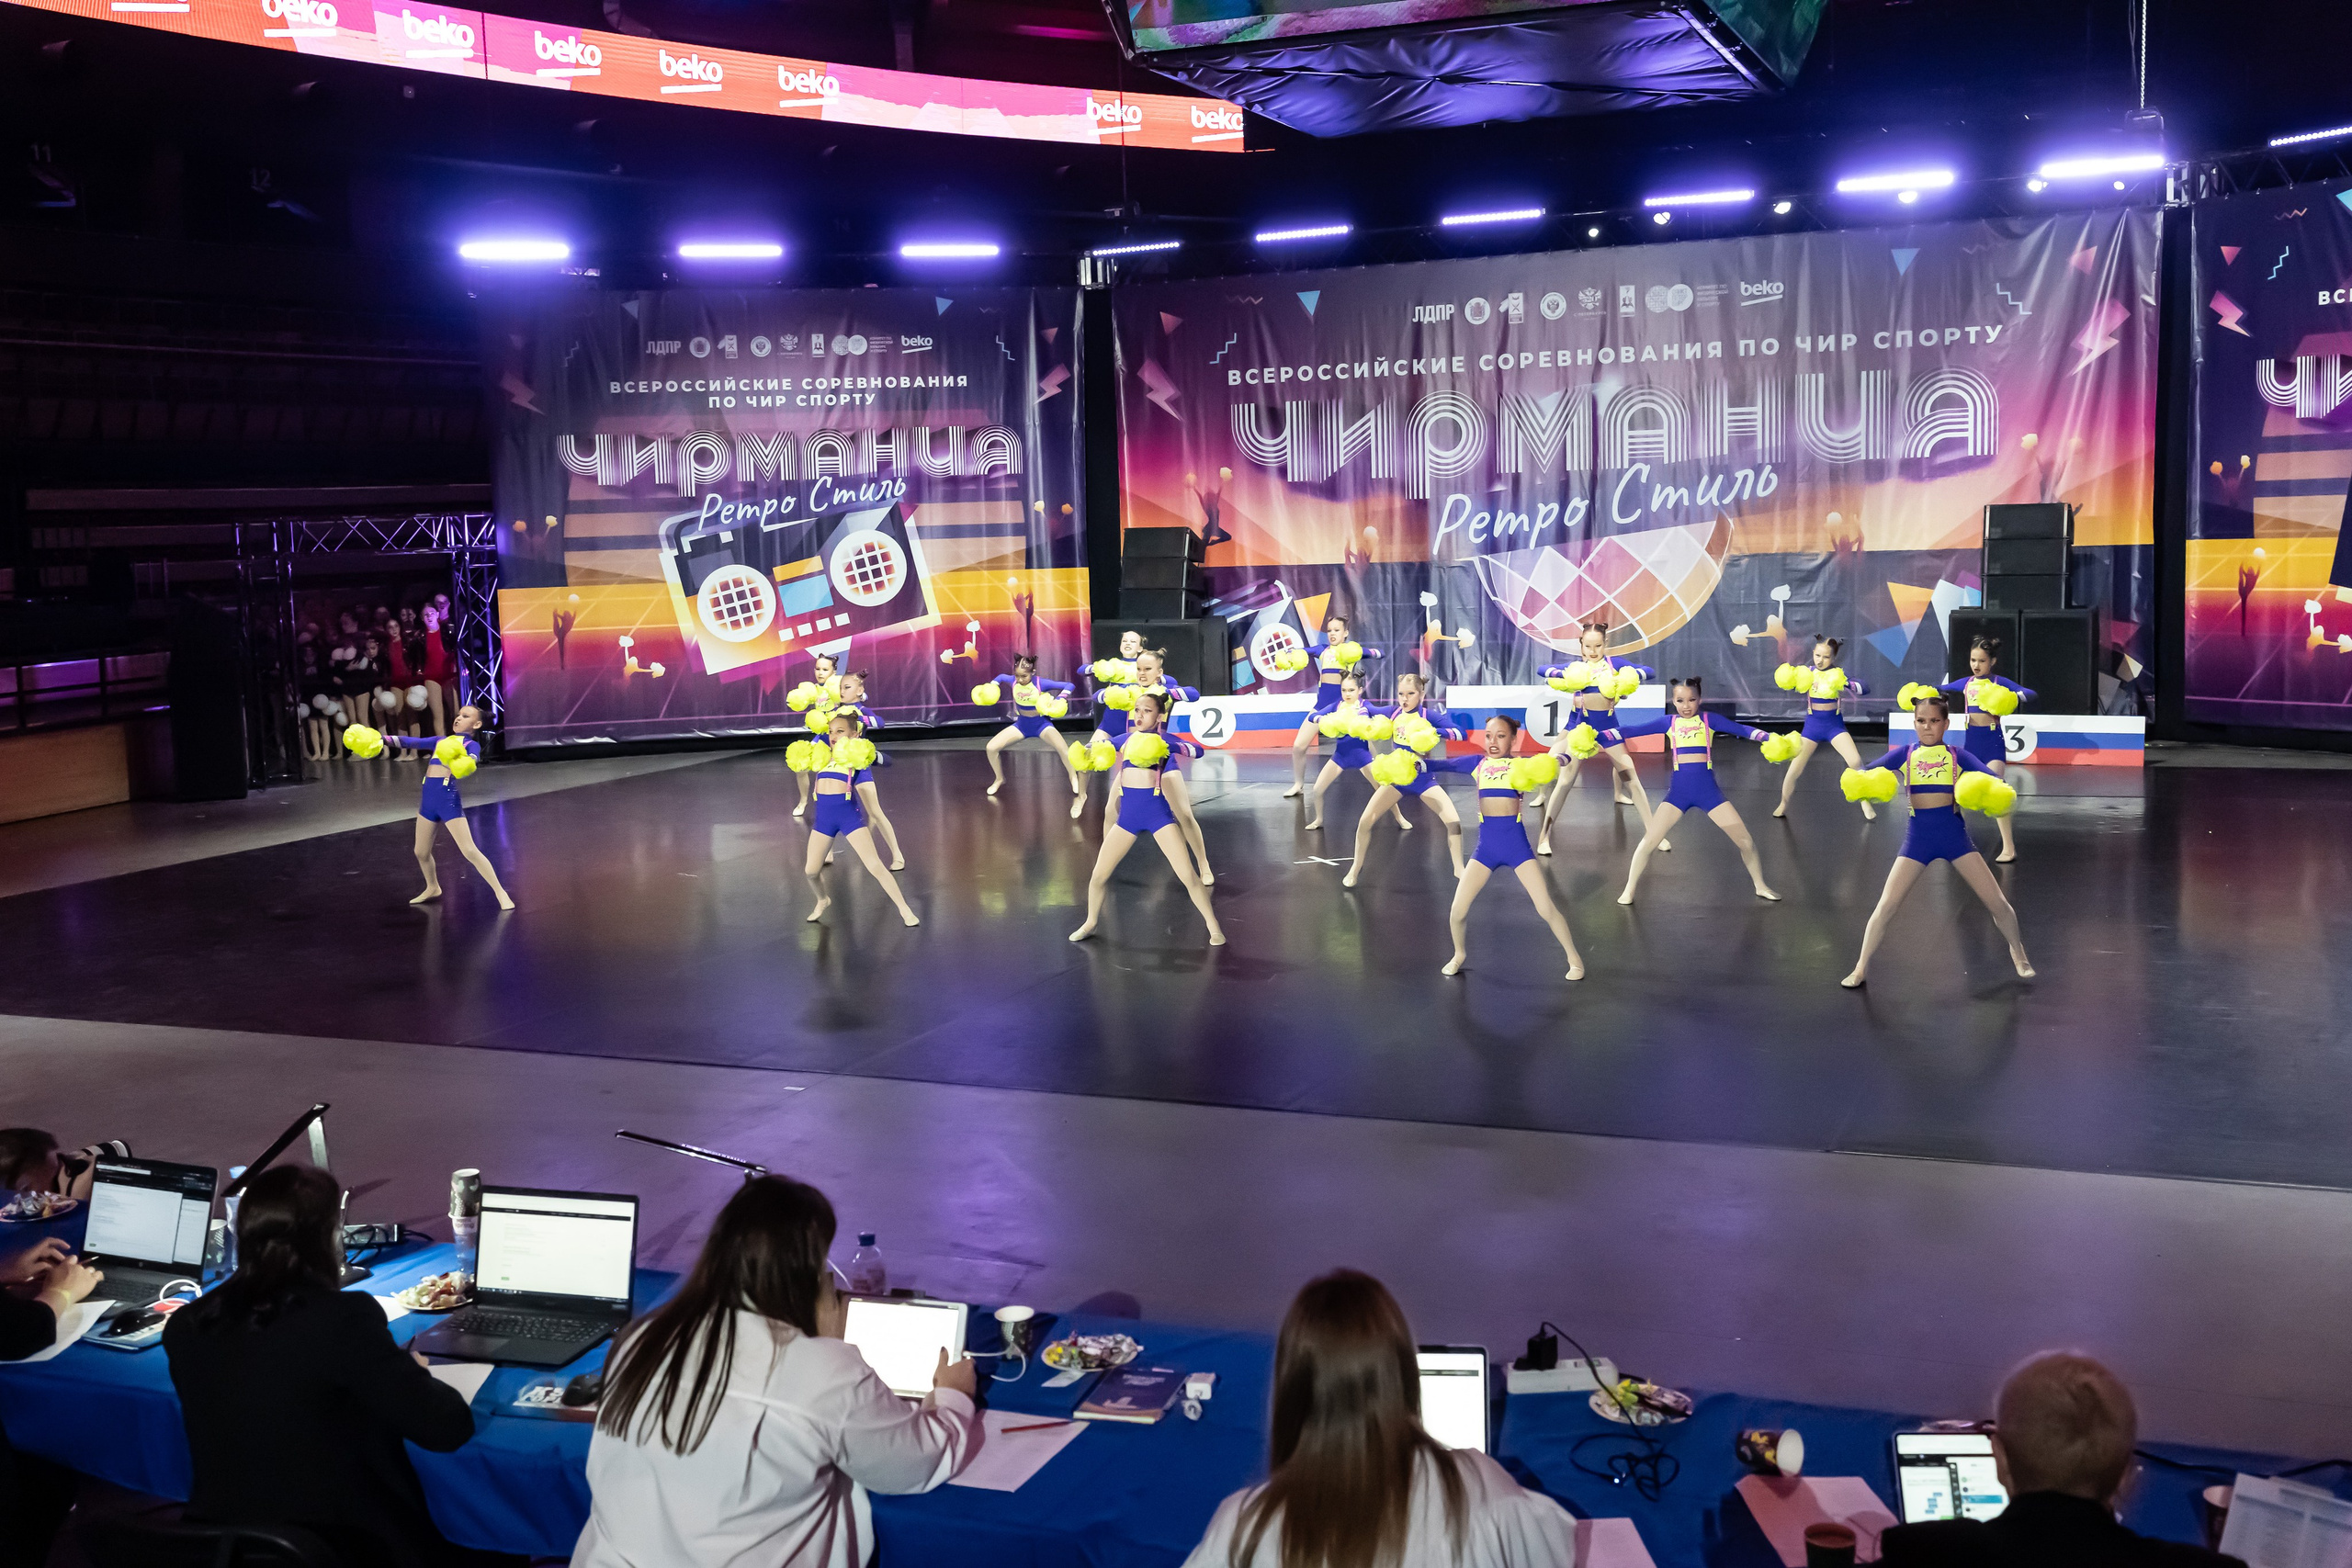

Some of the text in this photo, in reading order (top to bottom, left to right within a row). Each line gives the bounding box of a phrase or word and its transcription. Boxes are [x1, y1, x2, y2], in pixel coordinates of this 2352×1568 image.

[402, 9, 475, 49] beko
[534, 30, 603, 67] beko
[659, 49, 724, 84] beko
[777, 65, 841, 96] beko
[1086, 96, 1143, 124] beko
[1191, 105, 1244, 131] beko
[30, 142, 52, 163] 11
[1740, 280, 1784, 297] beko
[2318, 288, 2352, 306] ВС
[1412, 303, 1455, 323] ЛДПР
[646, 341, 682, 355] ЛДПР
[900, 335, 933, 347] beko
[1227, 324, 2004, 386] ВСЕРОССИЙСКИЕ СОРЕВНОВАНИЯ ПО ЧИР СПОРТУ
[610, 375, 968, 394] ВСЕРОССИЙСКИЕ СОРЕВНОВАНИЯ
[708, 393, 876, 409] ПО ЧИР СПОРТУ
[697, 476, 908, 533] Ретро Стиль
[1433, 461, 1779, 556] Ретро Стиль
[1202, 707, 1223, 738] 2
[1543, 700, 1559, 737] 1
[2005, 725, 2025, 753] 3
